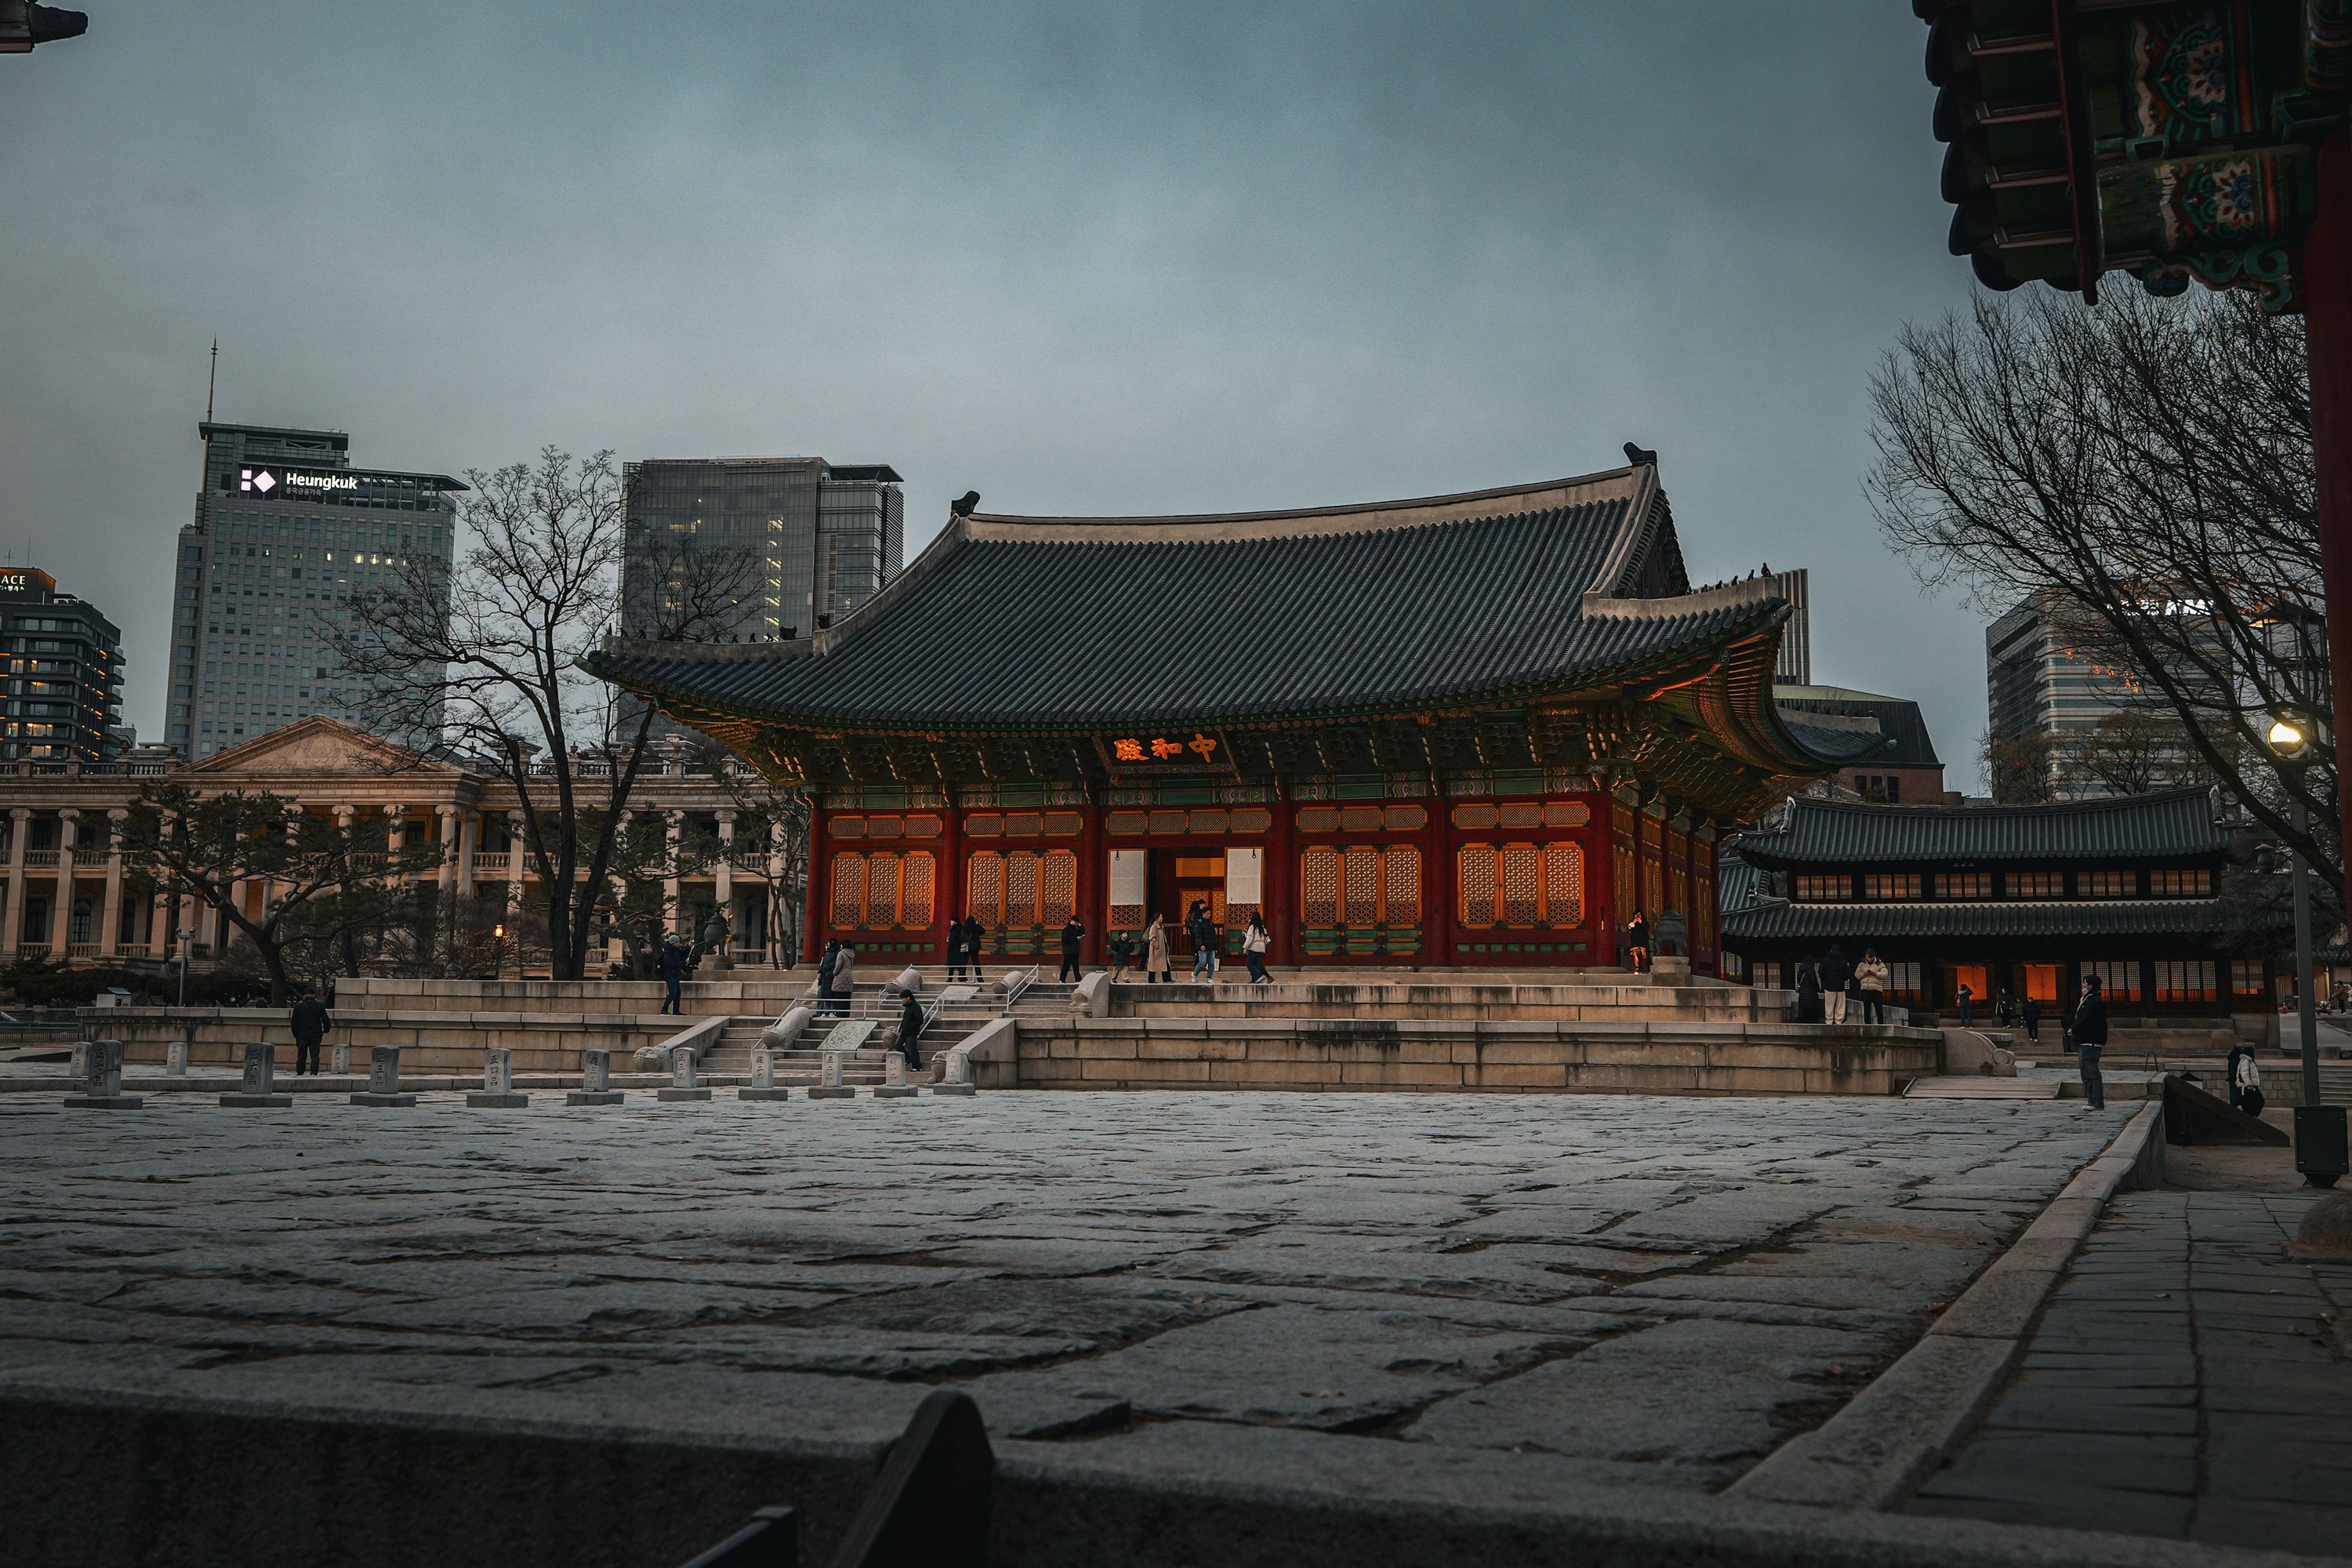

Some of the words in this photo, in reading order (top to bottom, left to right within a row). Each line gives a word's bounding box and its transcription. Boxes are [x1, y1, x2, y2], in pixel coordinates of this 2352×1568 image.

[286, 472, 358, 491] Heungkuk
[93, 1047, 104, 1087] 正七品
[248, 1050, 259, 1086] 正六品
[376, 1053, 386, 1087] 正五品
[489, 1054, 499, 1087] 正四品
[677, 1053, 686, 1081] 正三品
